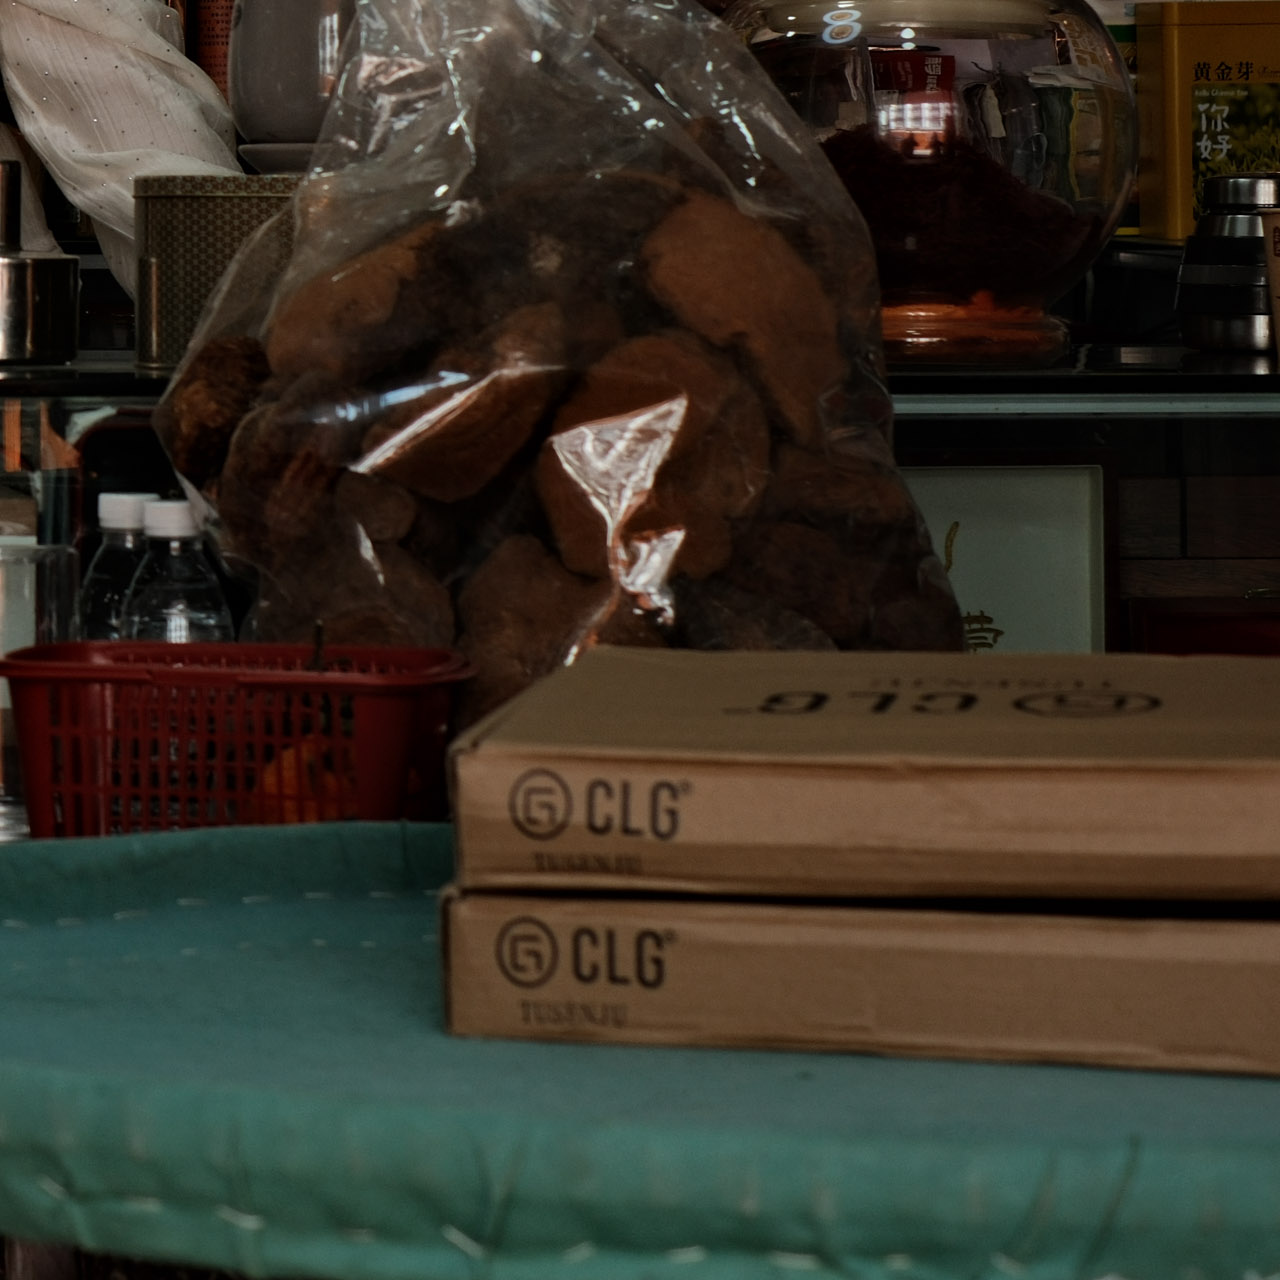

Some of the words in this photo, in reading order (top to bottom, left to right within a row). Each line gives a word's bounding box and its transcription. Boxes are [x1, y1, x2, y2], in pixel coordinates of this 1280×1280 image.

[1194, 61, 1253, 82] 黄金芽
[1195, 103, 1233, 161] 你好
